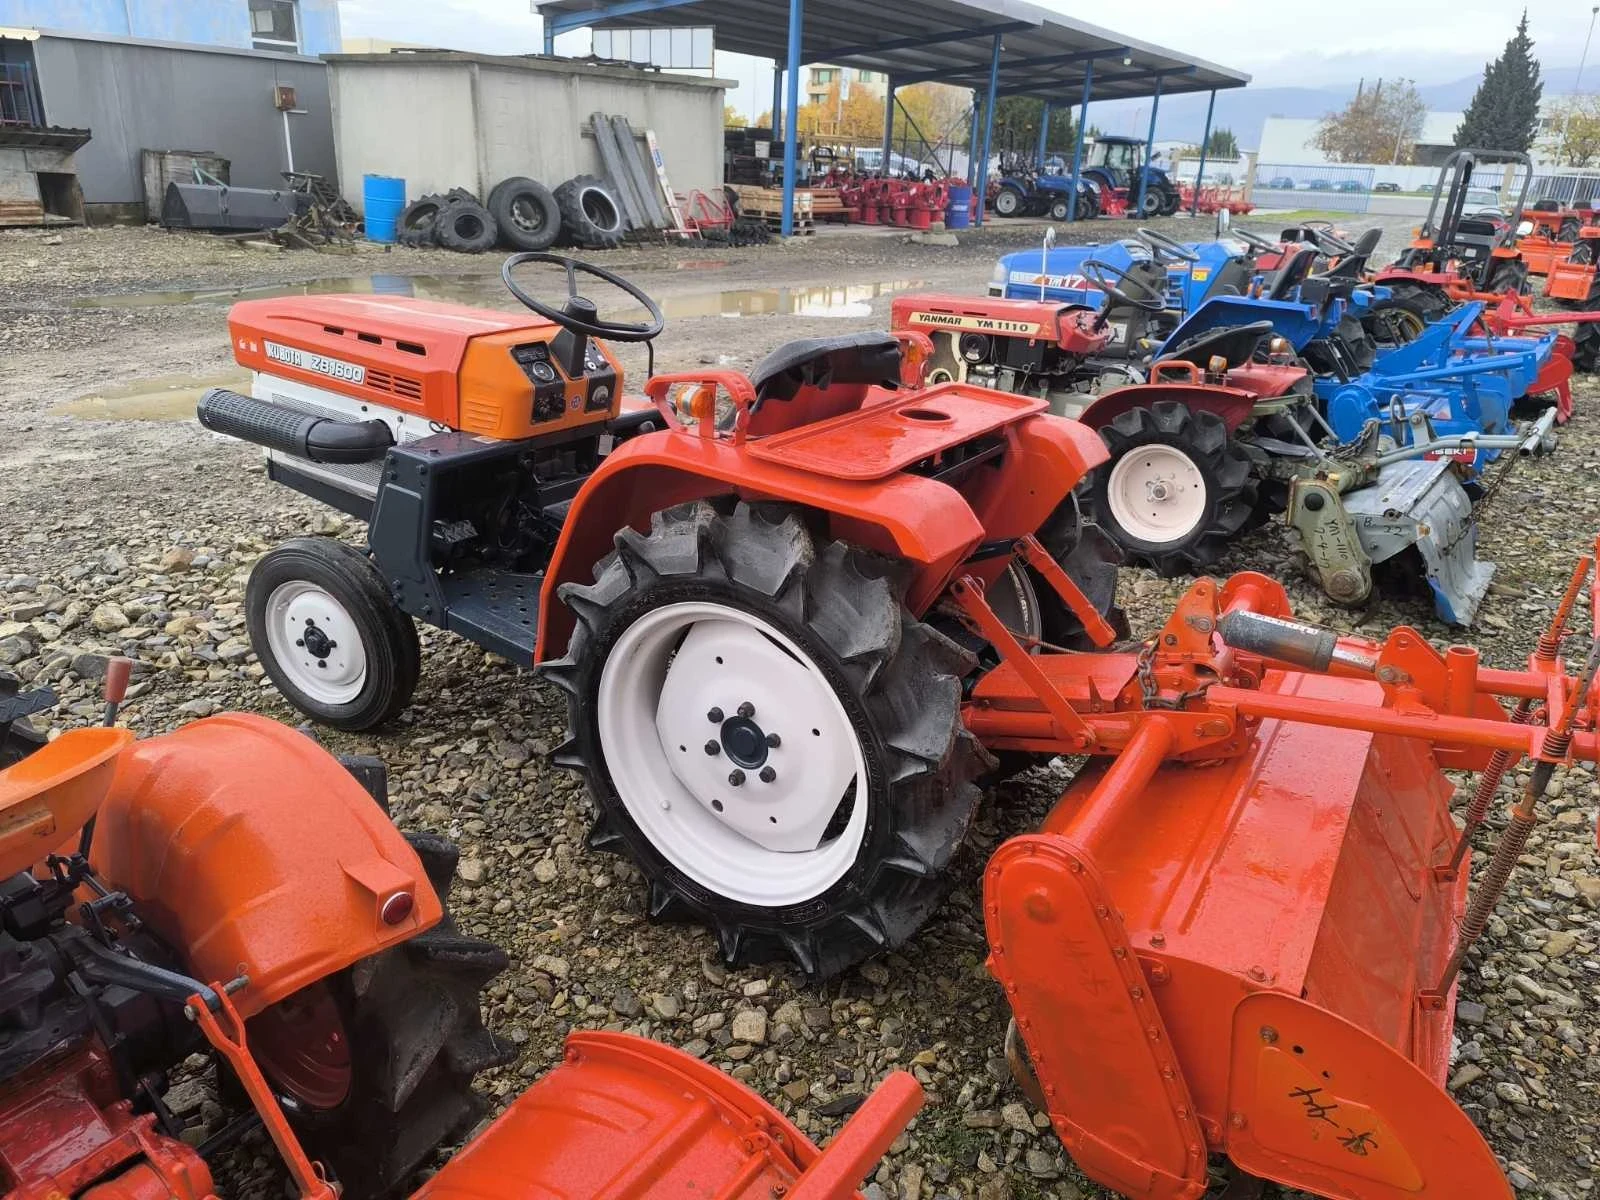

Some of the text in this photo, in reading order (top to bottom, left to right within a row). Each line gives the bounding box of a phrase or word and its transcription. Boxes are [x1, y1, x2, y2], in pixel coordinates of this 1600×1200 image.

[919, 313, 1029, 332] YANMAR YM 1110
[269, 343, 363, 382] KUBOTA ZB1600
